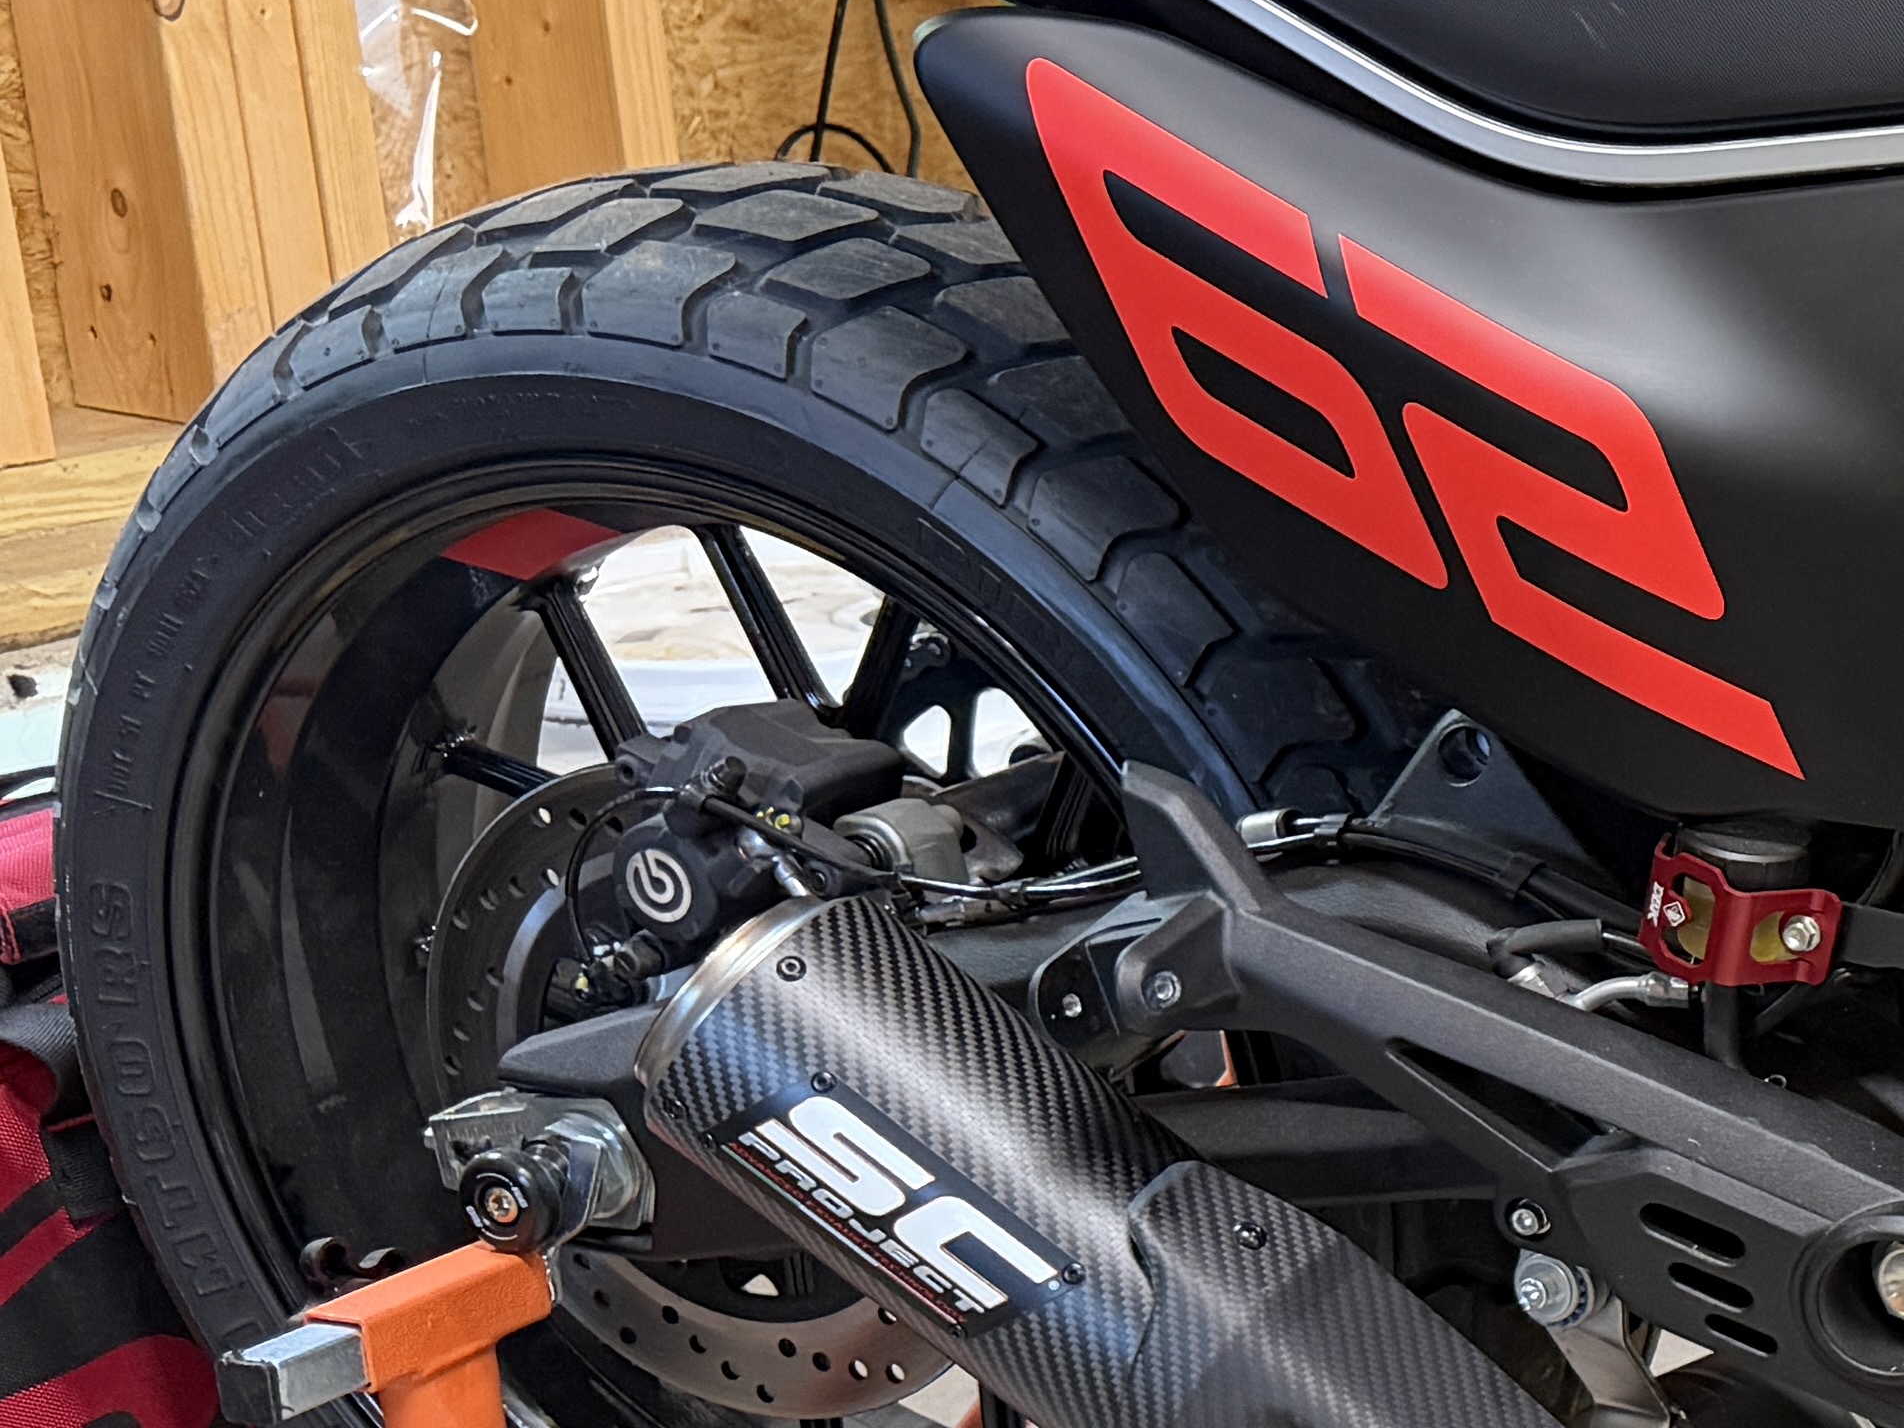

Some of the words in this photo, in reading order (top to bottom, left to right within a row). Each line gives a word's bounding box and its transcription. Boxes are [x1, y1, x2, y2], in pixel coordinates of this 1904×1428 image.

[1026, 58, 1805, 780] 62
[738, 1131, 986, 1314] PROJECT
[755, 1095, 1059, 1311] SC
